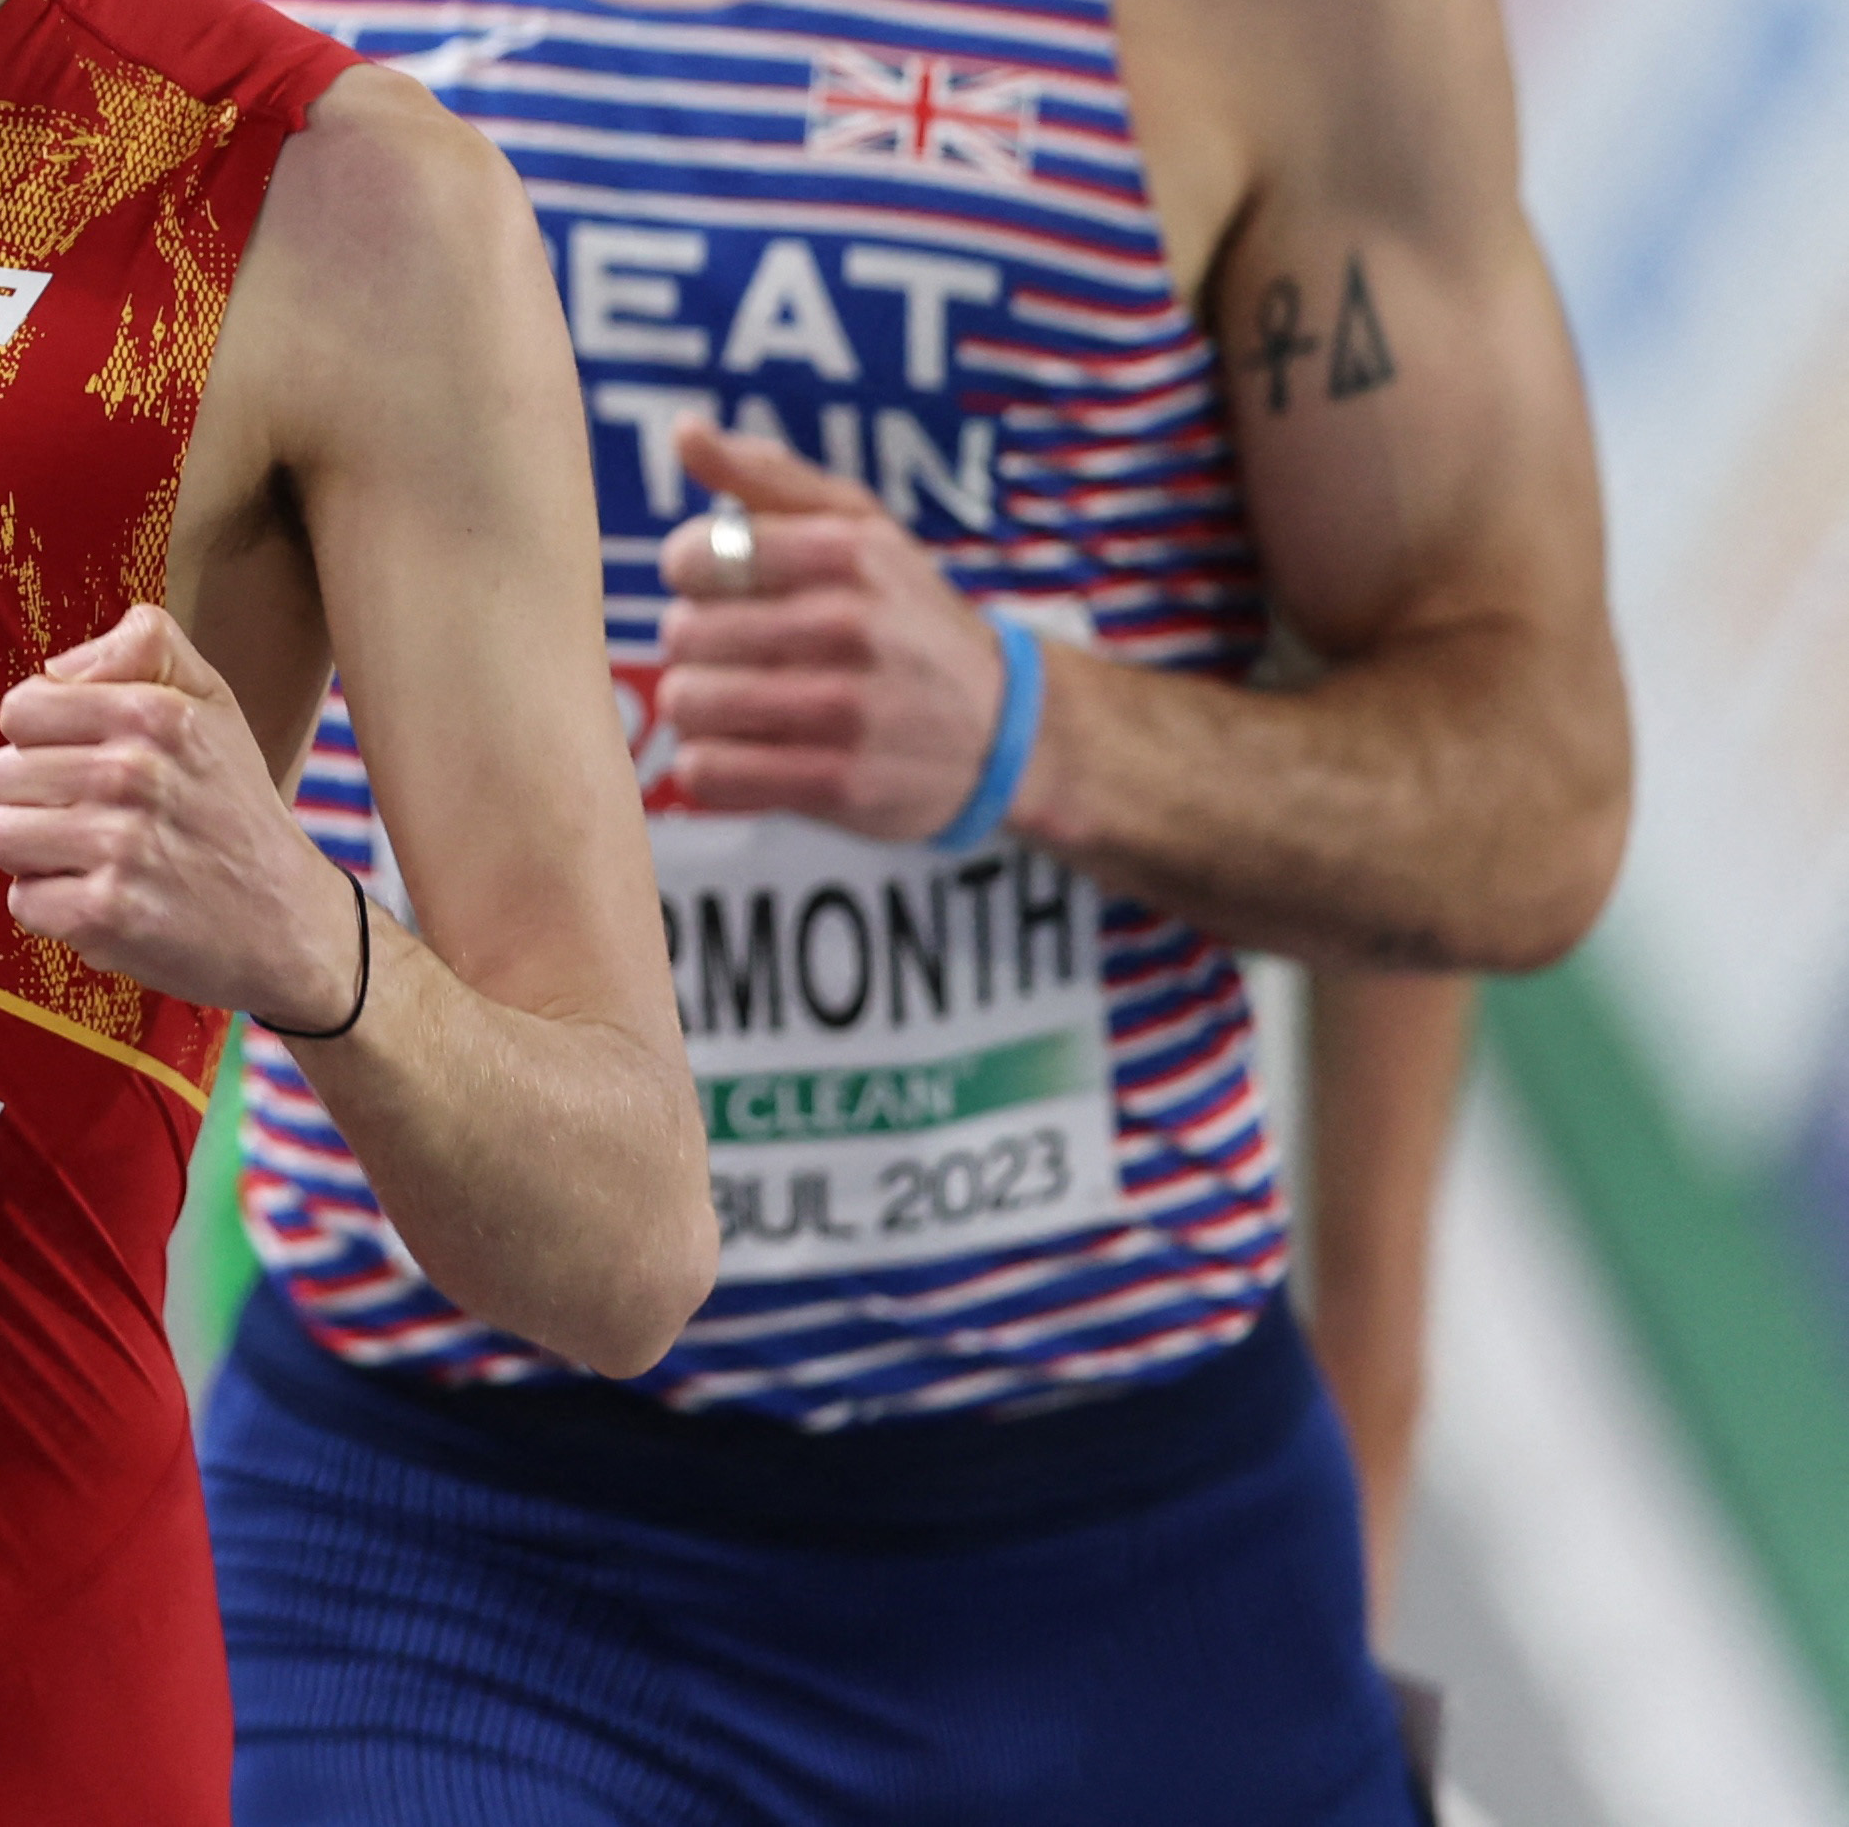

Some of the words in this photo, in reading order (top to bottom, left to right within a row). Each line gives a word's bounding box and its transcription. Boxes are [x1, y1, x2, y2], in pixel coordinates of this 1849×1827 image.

[544, 221, 1001, 392] EAT
[725, 1069, 955, 1140] CLEAN
[712, 1165, 856, 1245] BUL
[877, 1127, 1072, 1235] 2023
